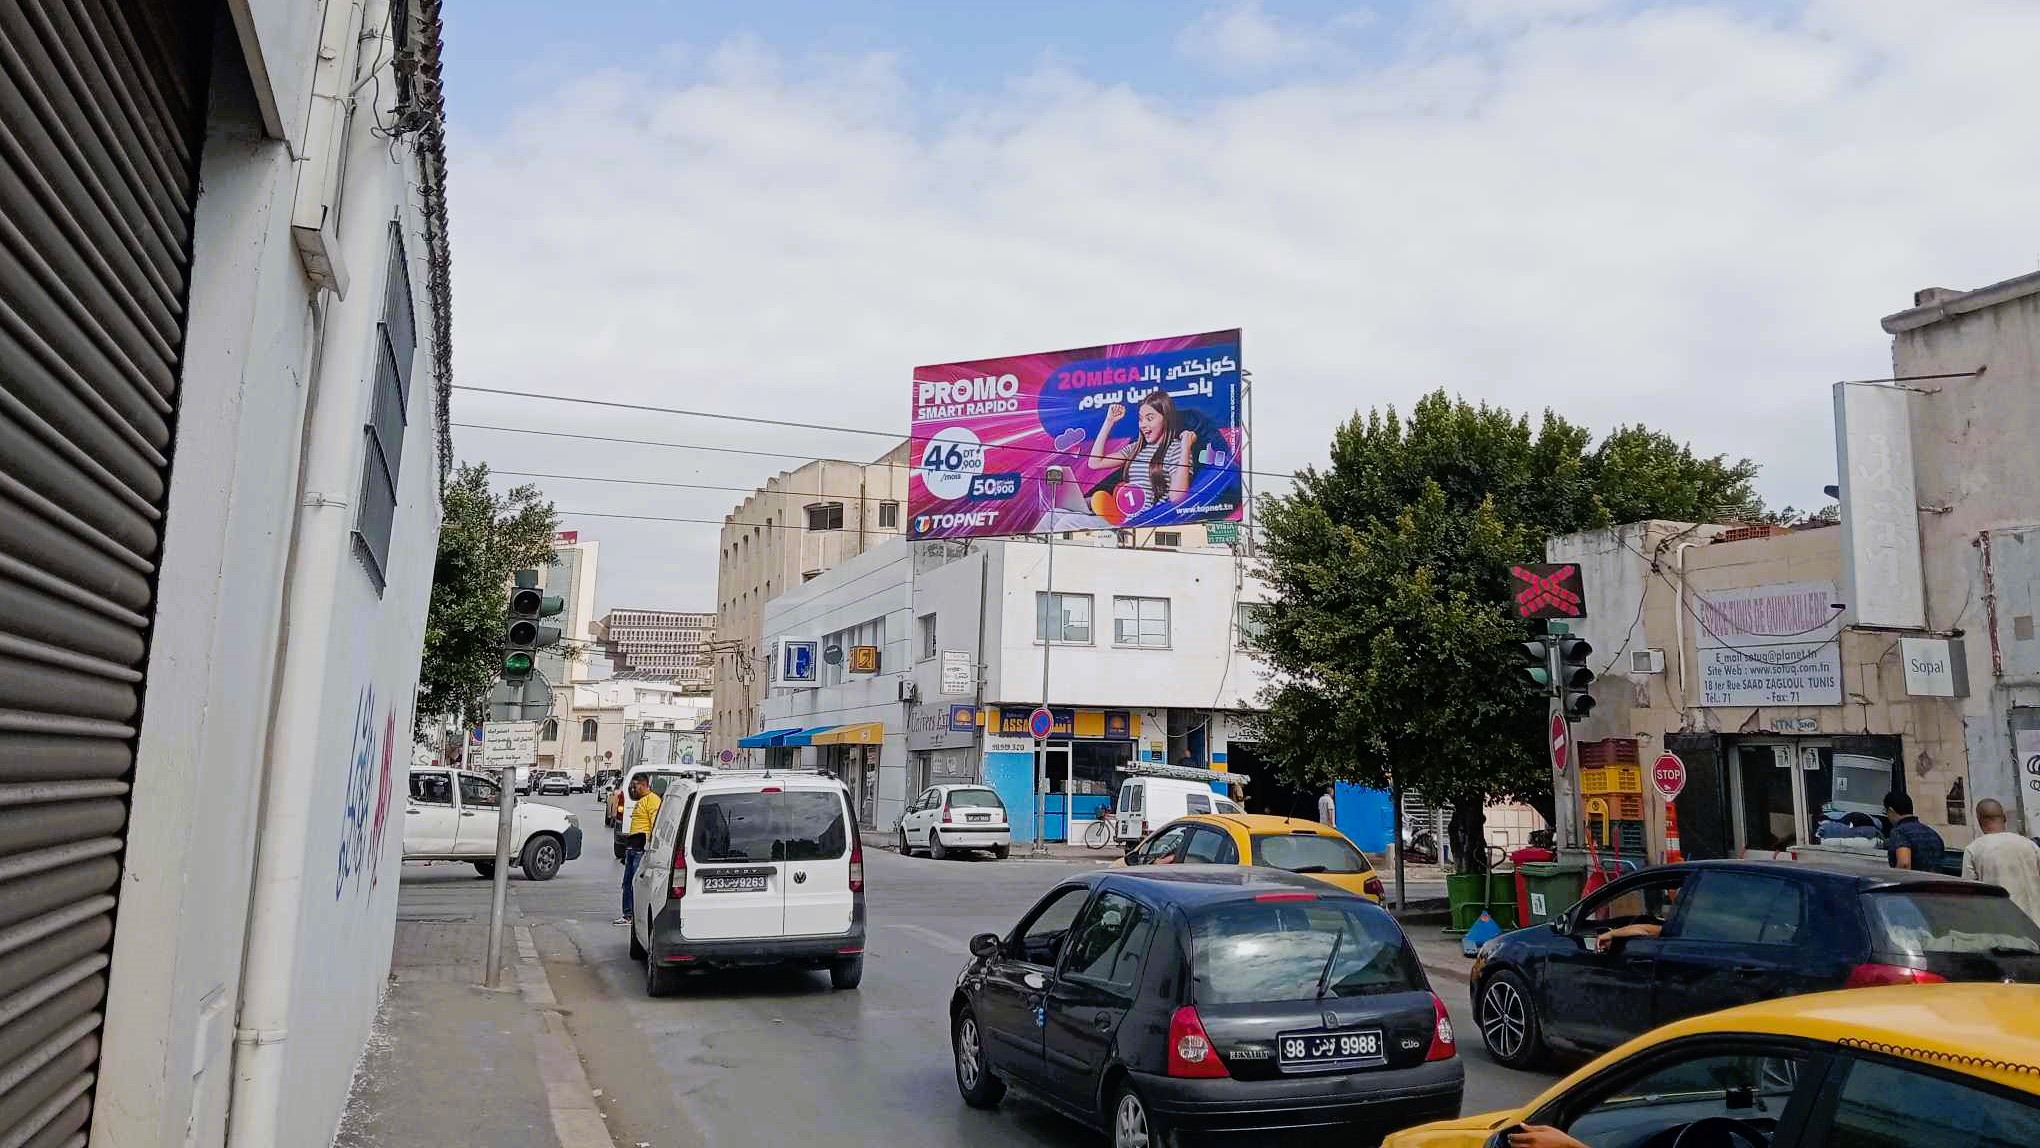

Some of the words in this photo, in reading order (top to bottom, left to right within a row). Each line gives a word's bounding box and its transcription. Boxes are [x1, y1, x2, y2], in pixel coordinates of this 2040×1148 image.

[1165, 356, 1236, 381] كونكتي
[919, 374, 1019, 406] PROMO
[1078, 389, 1124, 411] سوم
[917, 405, 966, 420] SMART
[966, 399, 1019, 416] RAPIDO
[924, 443, 963, 472] 46
[1124, 491, 1136, 507] 1
[1176, 503, 1233, 515] www.topnet.tn
[931, 511, 1000, 530] TOPNET
[1707, 665, 1722, 676] Site
[1724, 665, 1742, 676] Web
[1911, 658, 1945, 676] Sopal
[1705, 680, 1713, 690] 18
[1727, 680, 1741, 690] Rue
[1742, 679, 1763, 689] SAAD
[1766, 678, 1804, 689] ZAGLOUL
[1809, 676, 1834, 688] TUNIS
[1723, 692, 1731, 703] 71
[1790, 691, 1800, 702] 71
[1656, 769, 1680, 780] STOP
[704, 878, 724, 889] 233
[740, 876, 765, 888] 9263
[1230, 1050, 1270, 1060] RENAULT
[1285, 1039, 1306, 1058] 98
[1312, 1037, 1336, 1056] تونس
[1340, 1035, 1376, 1055] 9988
